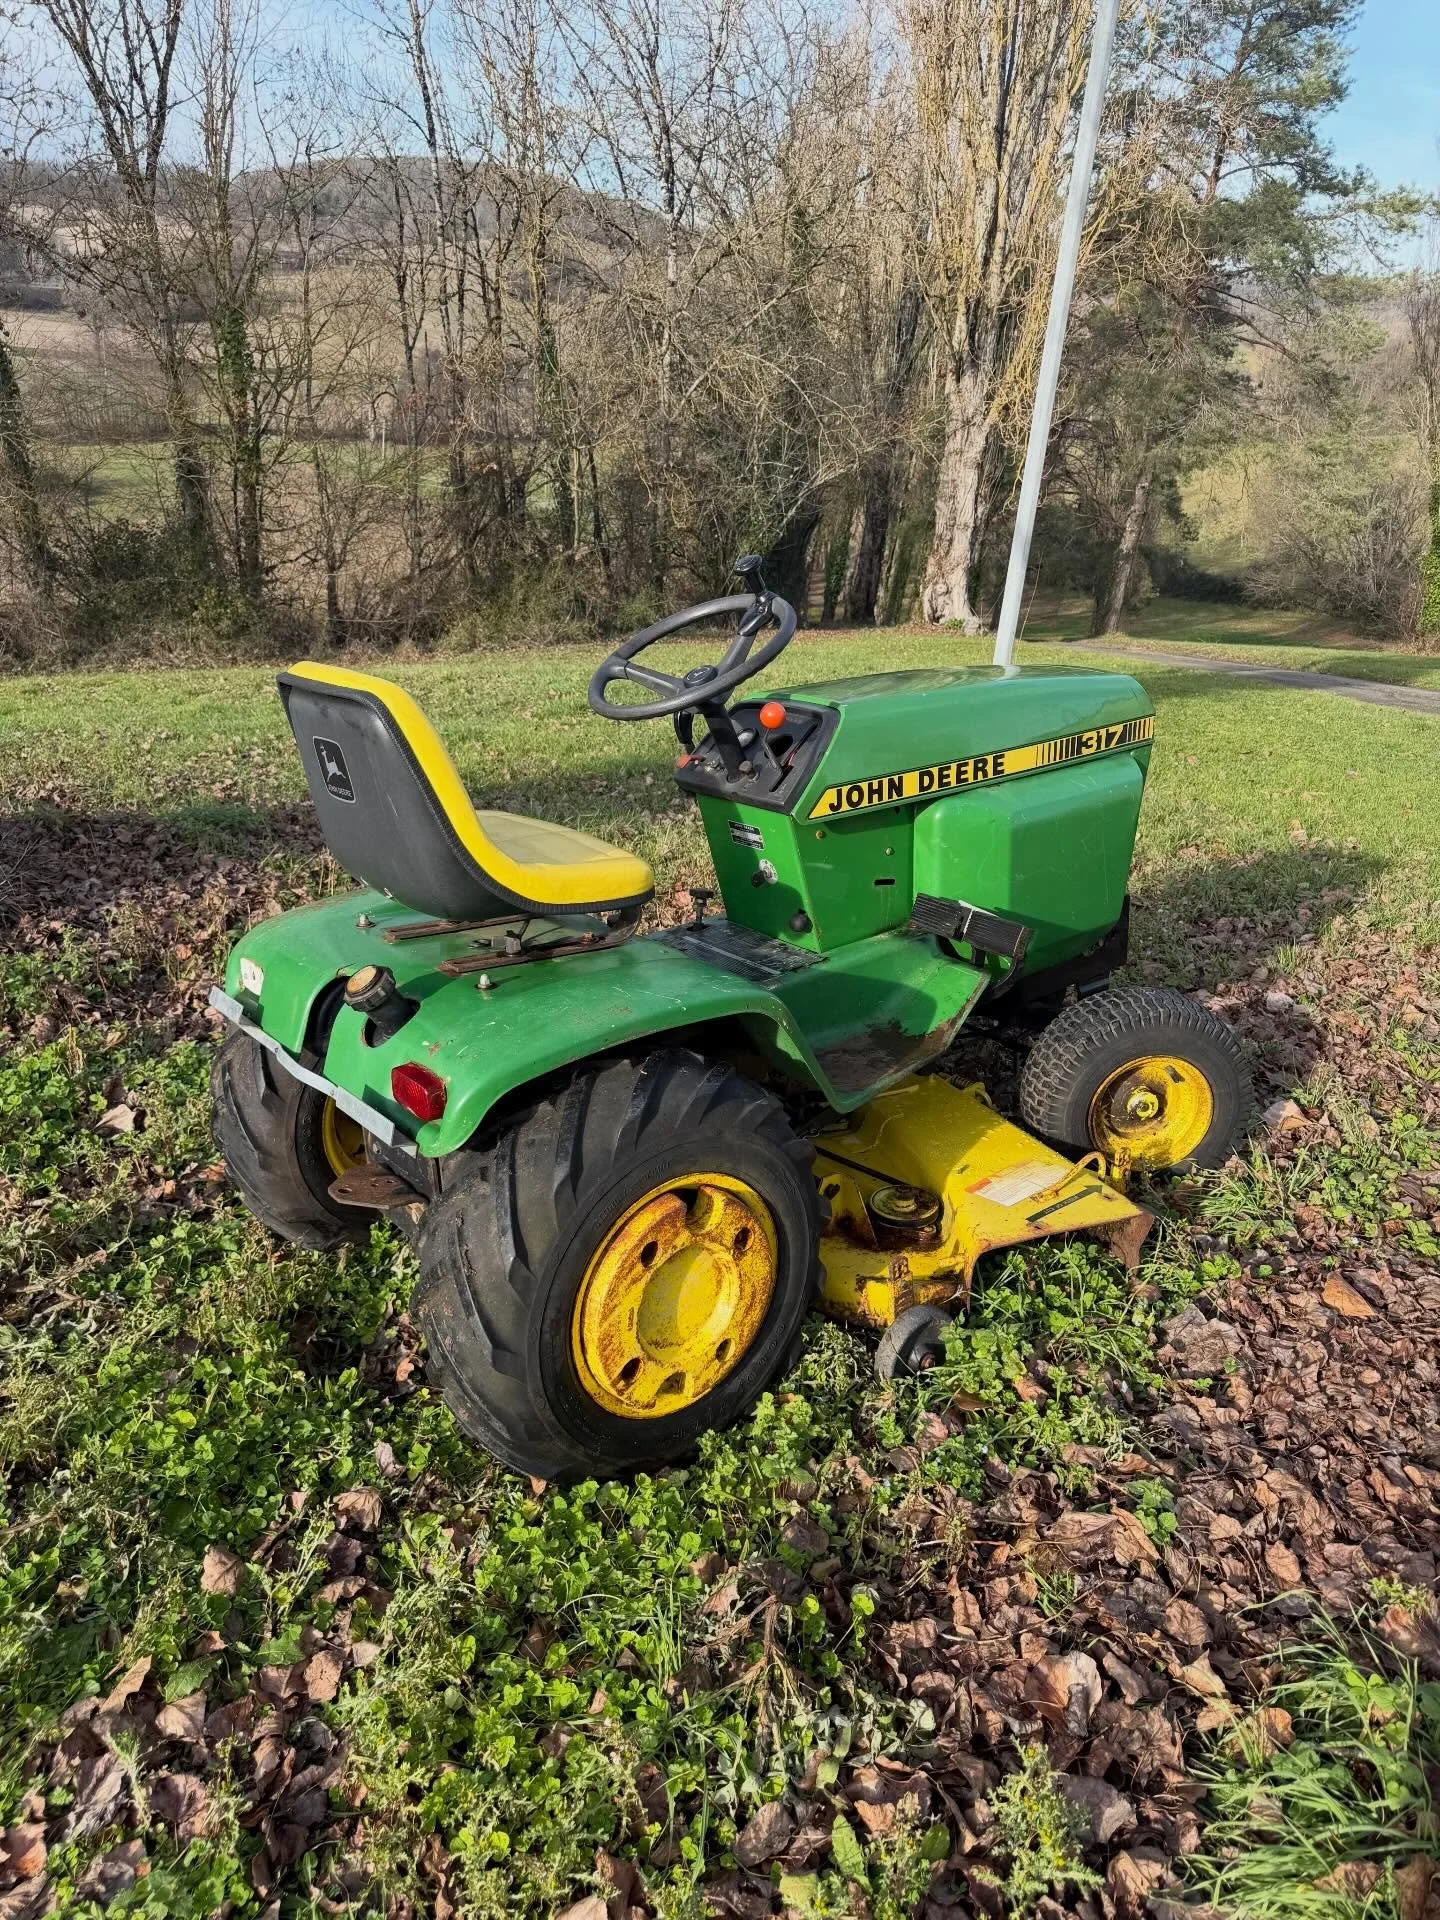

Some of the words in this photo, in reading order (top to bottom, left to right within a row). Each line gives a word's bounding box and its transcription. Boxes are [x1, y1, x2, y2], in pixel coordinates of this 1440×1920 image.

[829, 776, 903, 812] JOHN
[919, 754, 1005, 792] DEERE
[1081, 726, 1124, 754] 317
